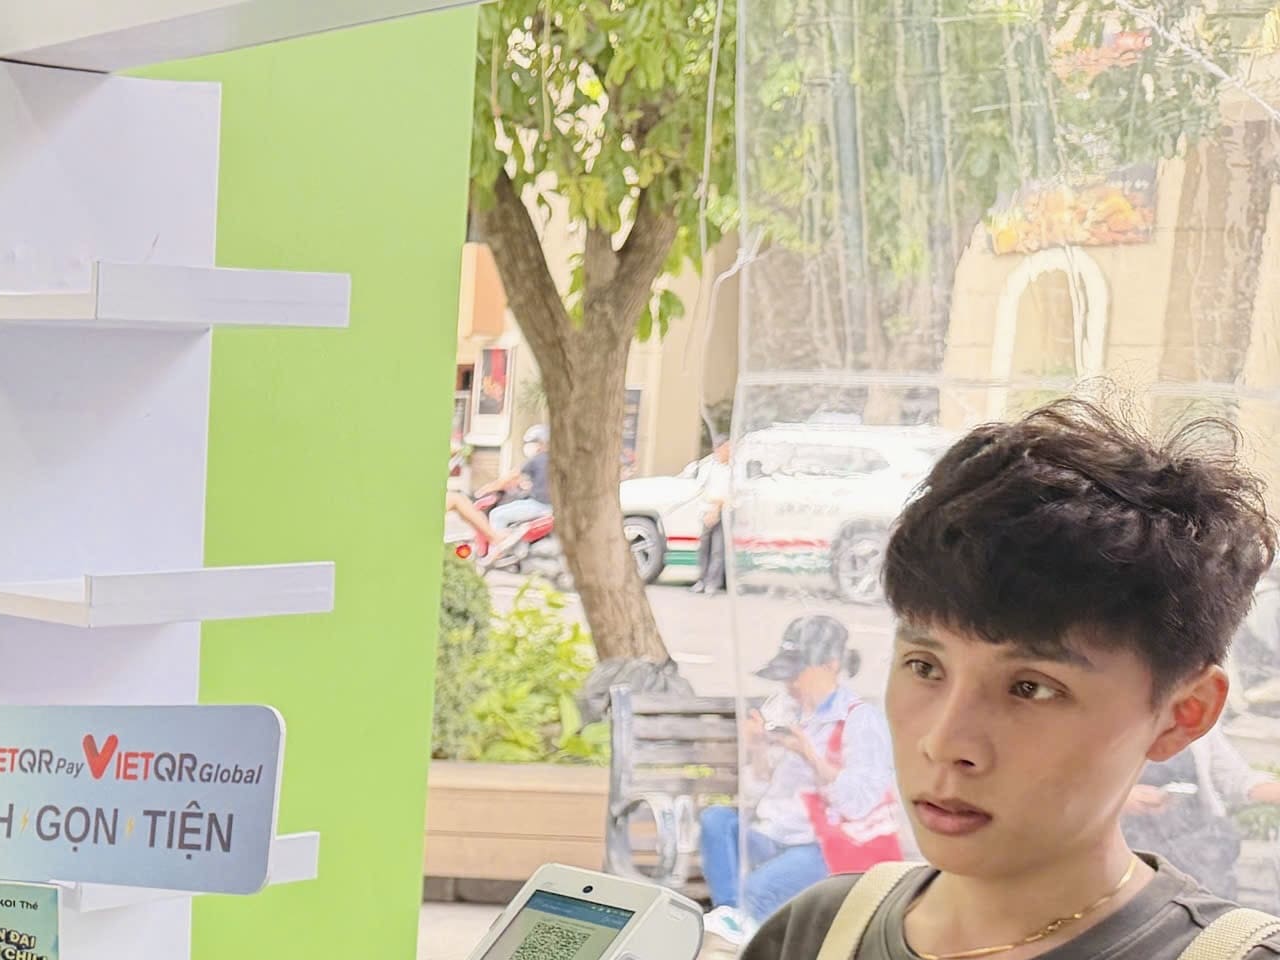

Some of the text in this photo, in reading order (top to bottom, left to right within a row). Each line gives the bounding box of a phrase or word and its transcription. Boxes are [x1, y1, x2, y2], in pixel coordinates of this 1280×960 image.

[36, 804, 118, 853] GỌN
[143, 800, 233, 860] TIỆN
[20, 900, 39, 910] Thé
[9, 931, 36, 949] ĐẠI
